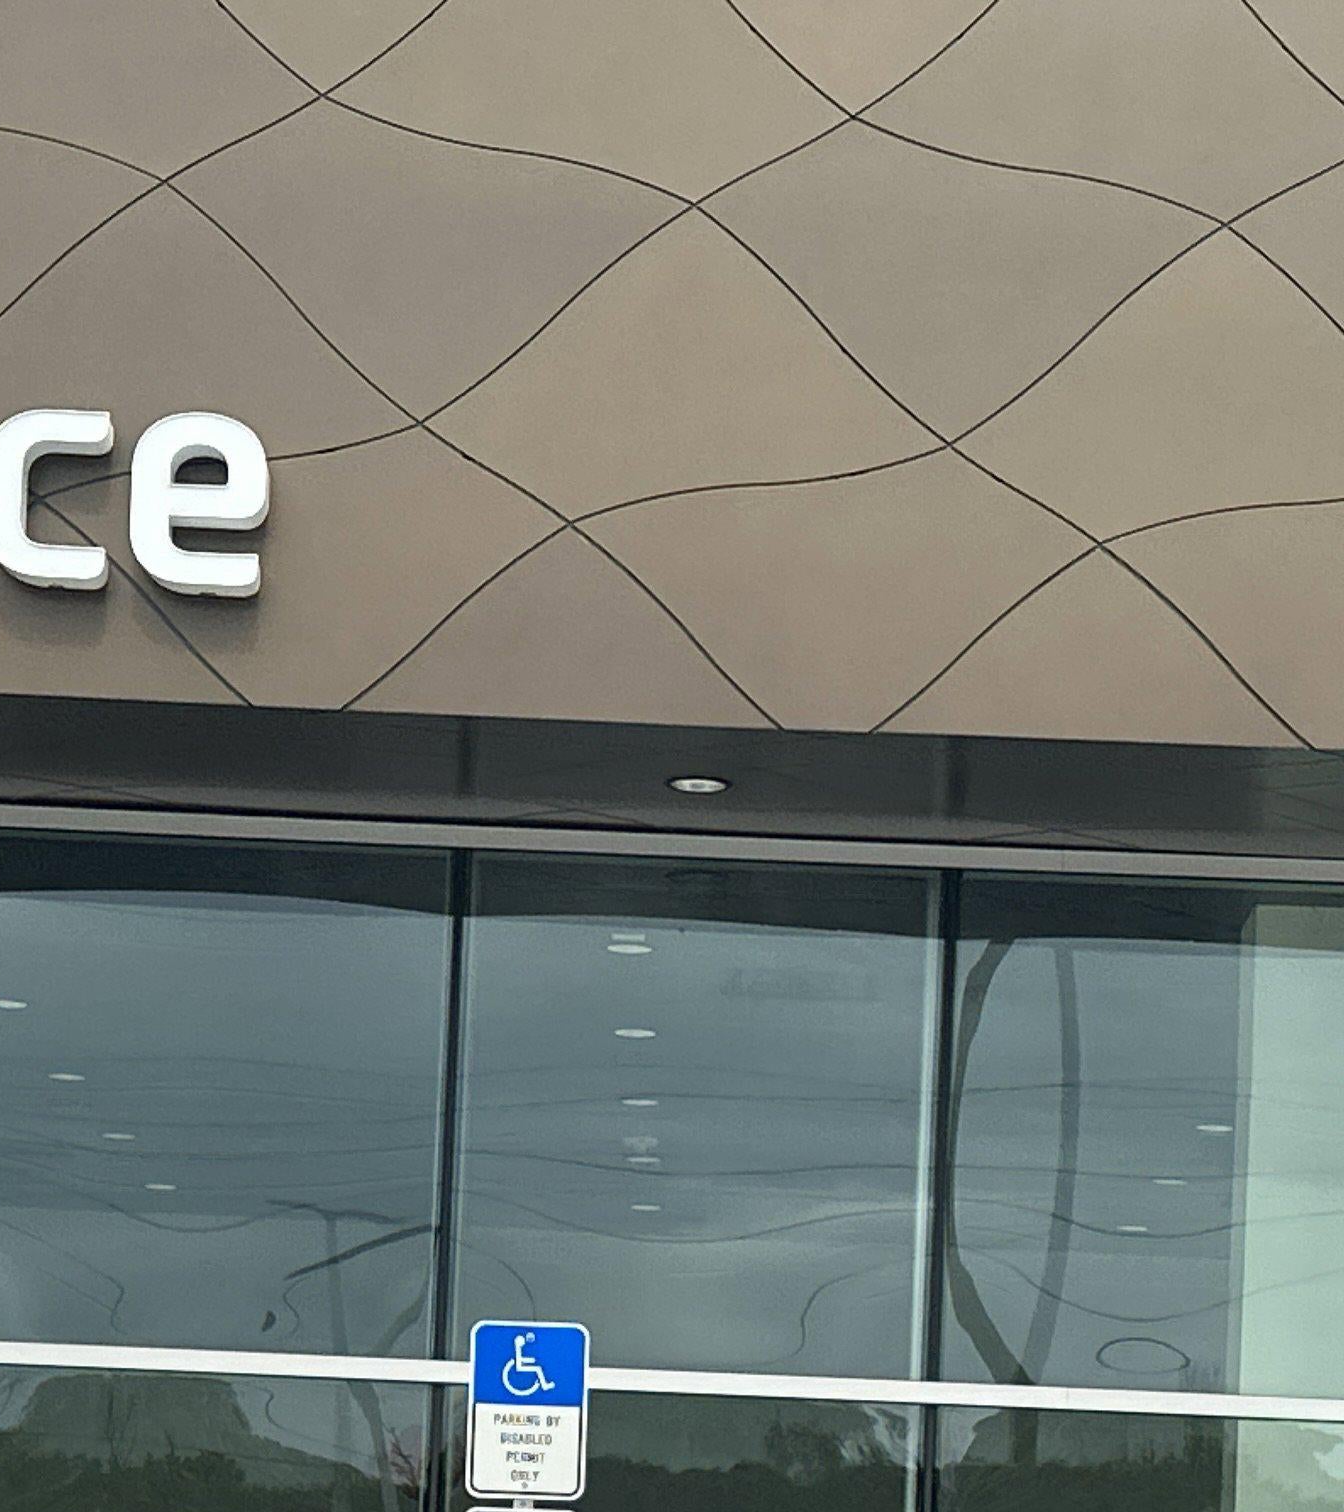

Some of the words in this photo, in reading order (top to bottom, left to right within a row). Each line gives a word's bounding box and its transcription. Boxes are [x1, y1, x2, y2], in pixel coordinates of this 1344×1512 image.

[494, 1413, 540, 1427] PARKING
[546, 1415, 561, 1428] BY
[500, 1431, 552, 1445] DISABLED
